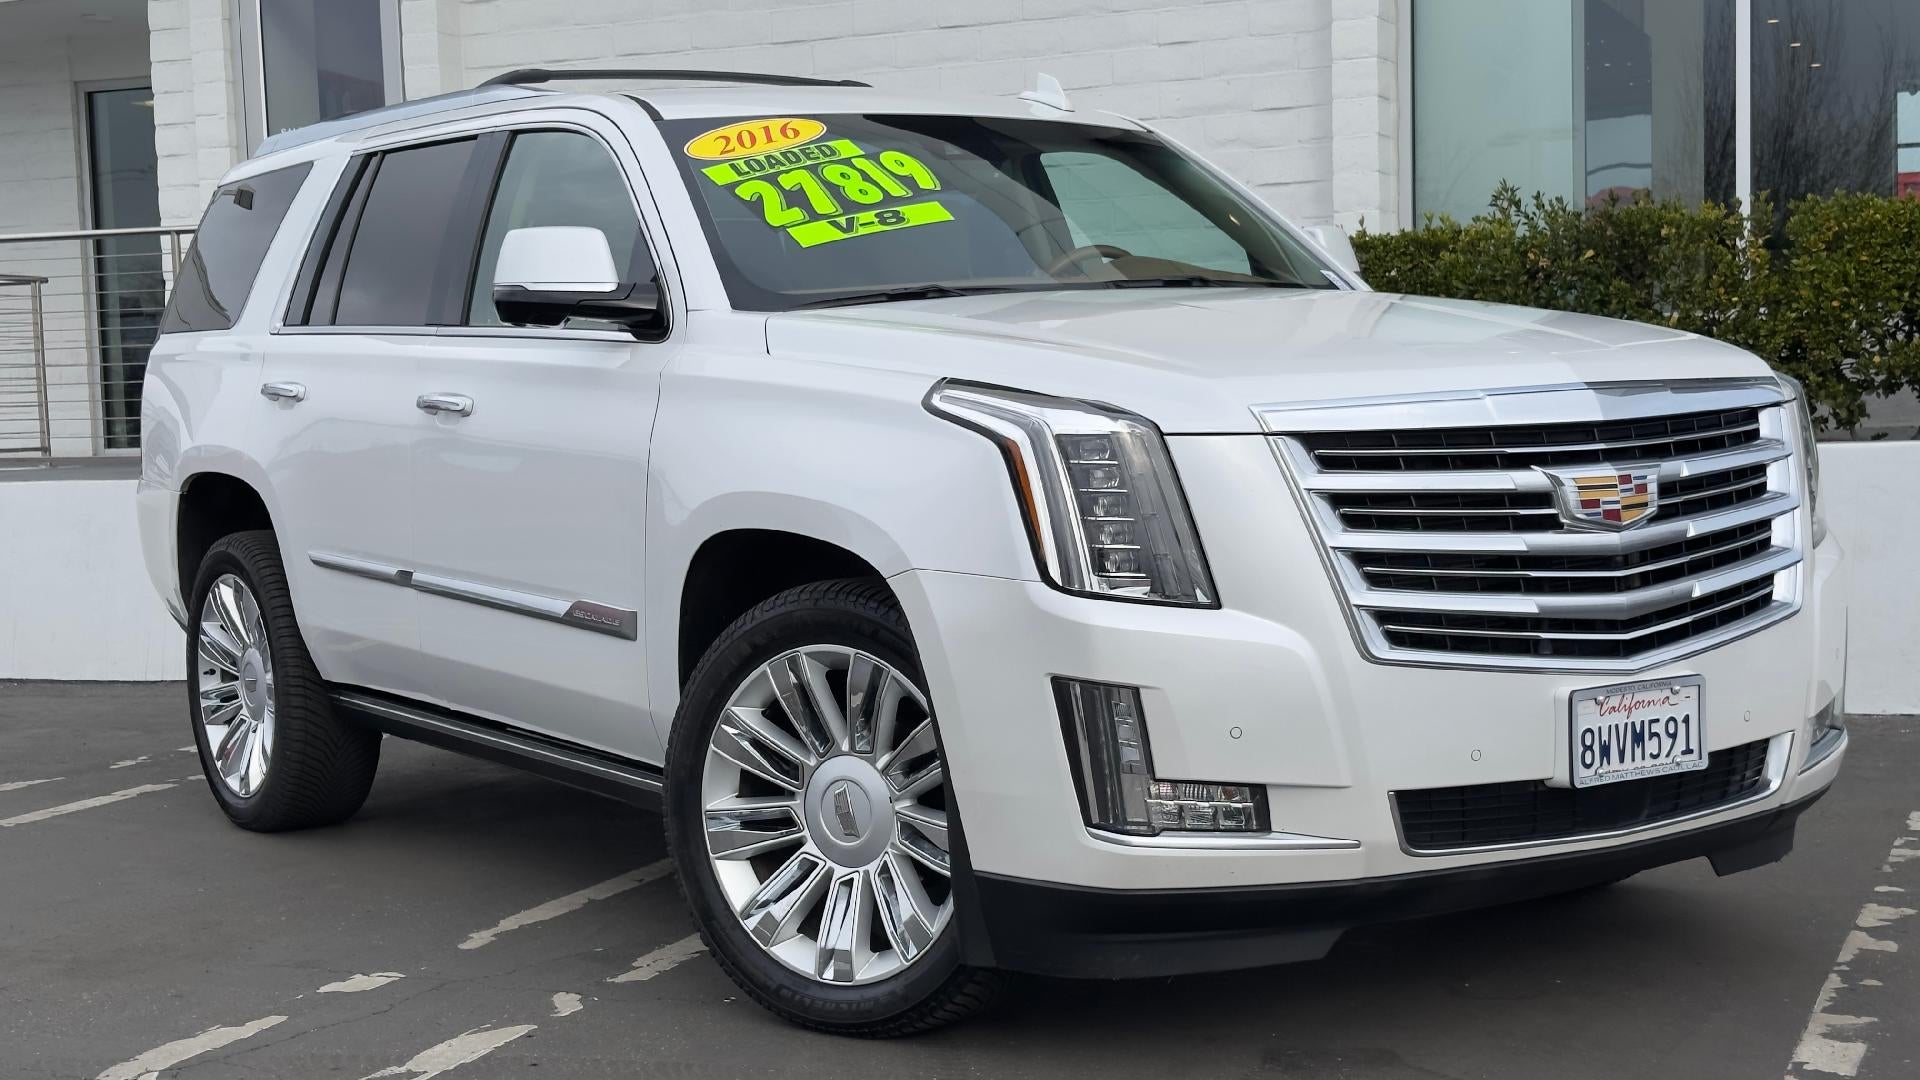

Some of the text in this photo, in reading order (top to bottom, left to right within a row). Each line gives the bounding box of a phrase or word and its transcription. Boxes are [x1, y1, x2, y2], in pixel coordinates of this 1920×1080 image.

[713, 120, 801, 156] 2016
[728, 143, 842, 178] LOADED
[734, 150, 942, 228] 27819
[827, 209, 910, 234] V-8
[1637, 681, 1672, 691] CALIFORNIA
[1600, 693, 1679, 719] California
[1580, 713, 1694, 769] 8WVM591
[1579, 774, 1611, 785] ALFRED
[1612, 767, 1661, 781] MATTHEWS
[1662, 761, 1703, 773] CADILLAC
